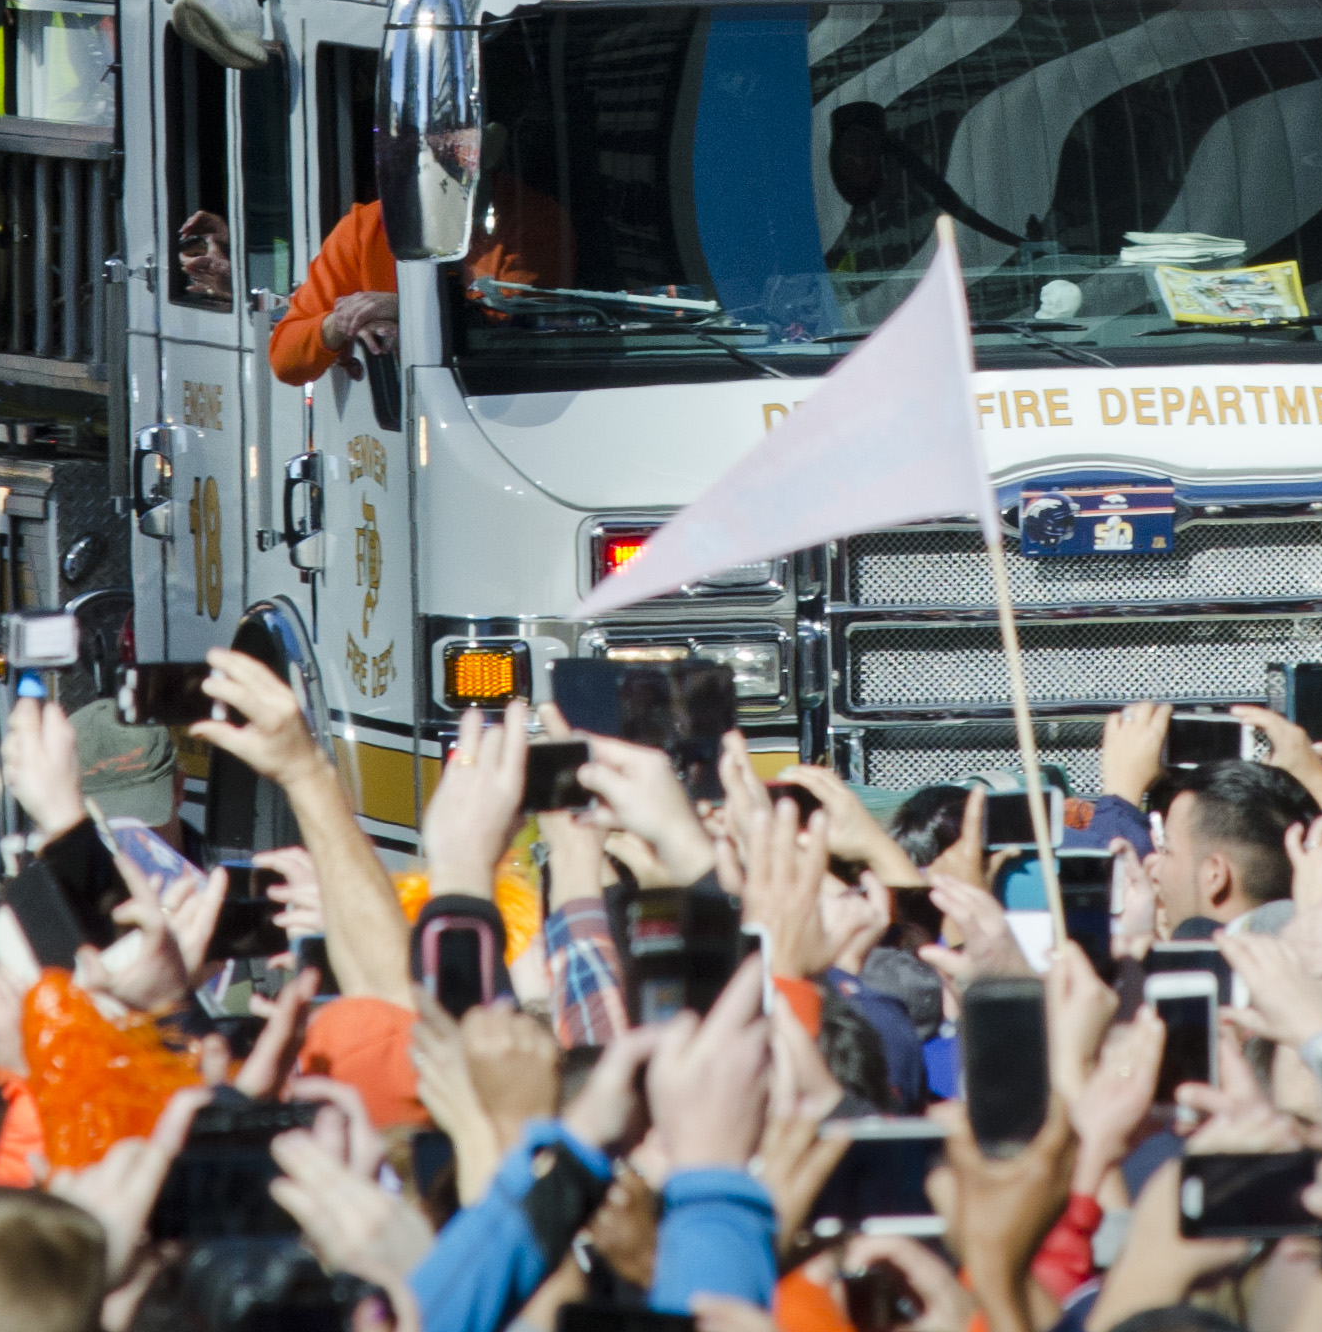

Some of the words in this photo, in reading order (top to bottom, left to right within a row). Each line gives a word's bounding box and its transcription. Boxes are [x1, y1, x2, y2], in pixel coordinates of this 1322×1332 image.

[182, 379, 223, 431] ENGINE
[976, 388, 1074, 430] FIRE
[346, 434, 388, 492] DENVER
[189, 475, 223, 621] 18
